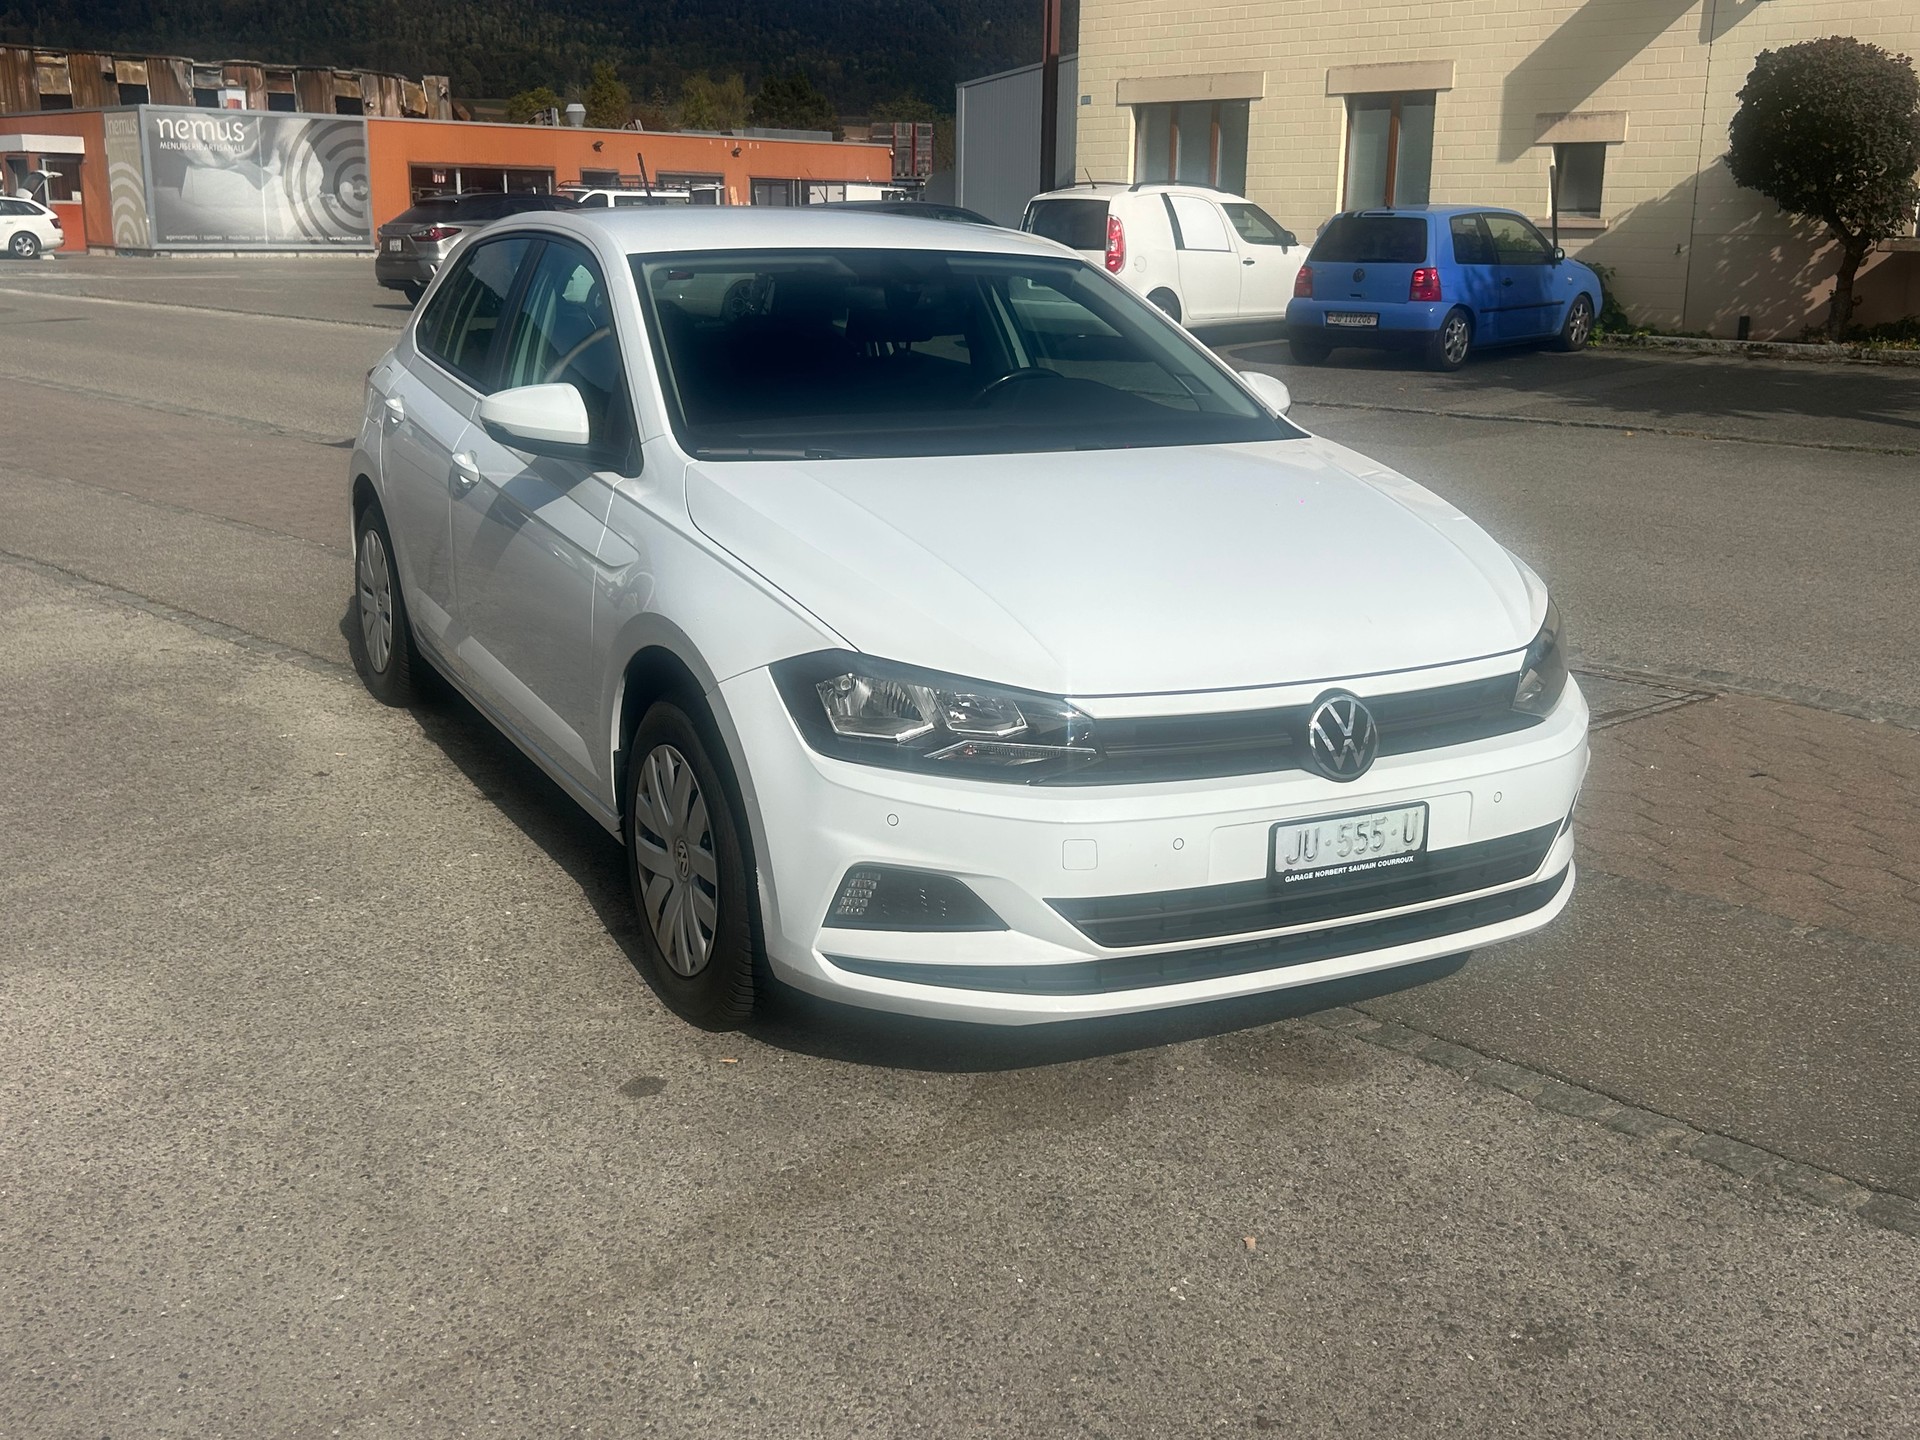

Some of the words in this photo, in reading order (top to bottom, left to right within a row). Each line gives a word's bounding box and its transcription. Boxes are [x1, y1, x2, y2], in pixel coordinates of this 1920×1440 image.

[108, 118, 137, 135] nemus
[156, 118, 245, 142] nemus
[1284, 871, 1314, 883] GARAGE
[1314, 866, 1347, 878] NORBERT
[1347, 861, 1377, 874] SAUVAIN
[1377, 855, 1414, 868] COURROUX
